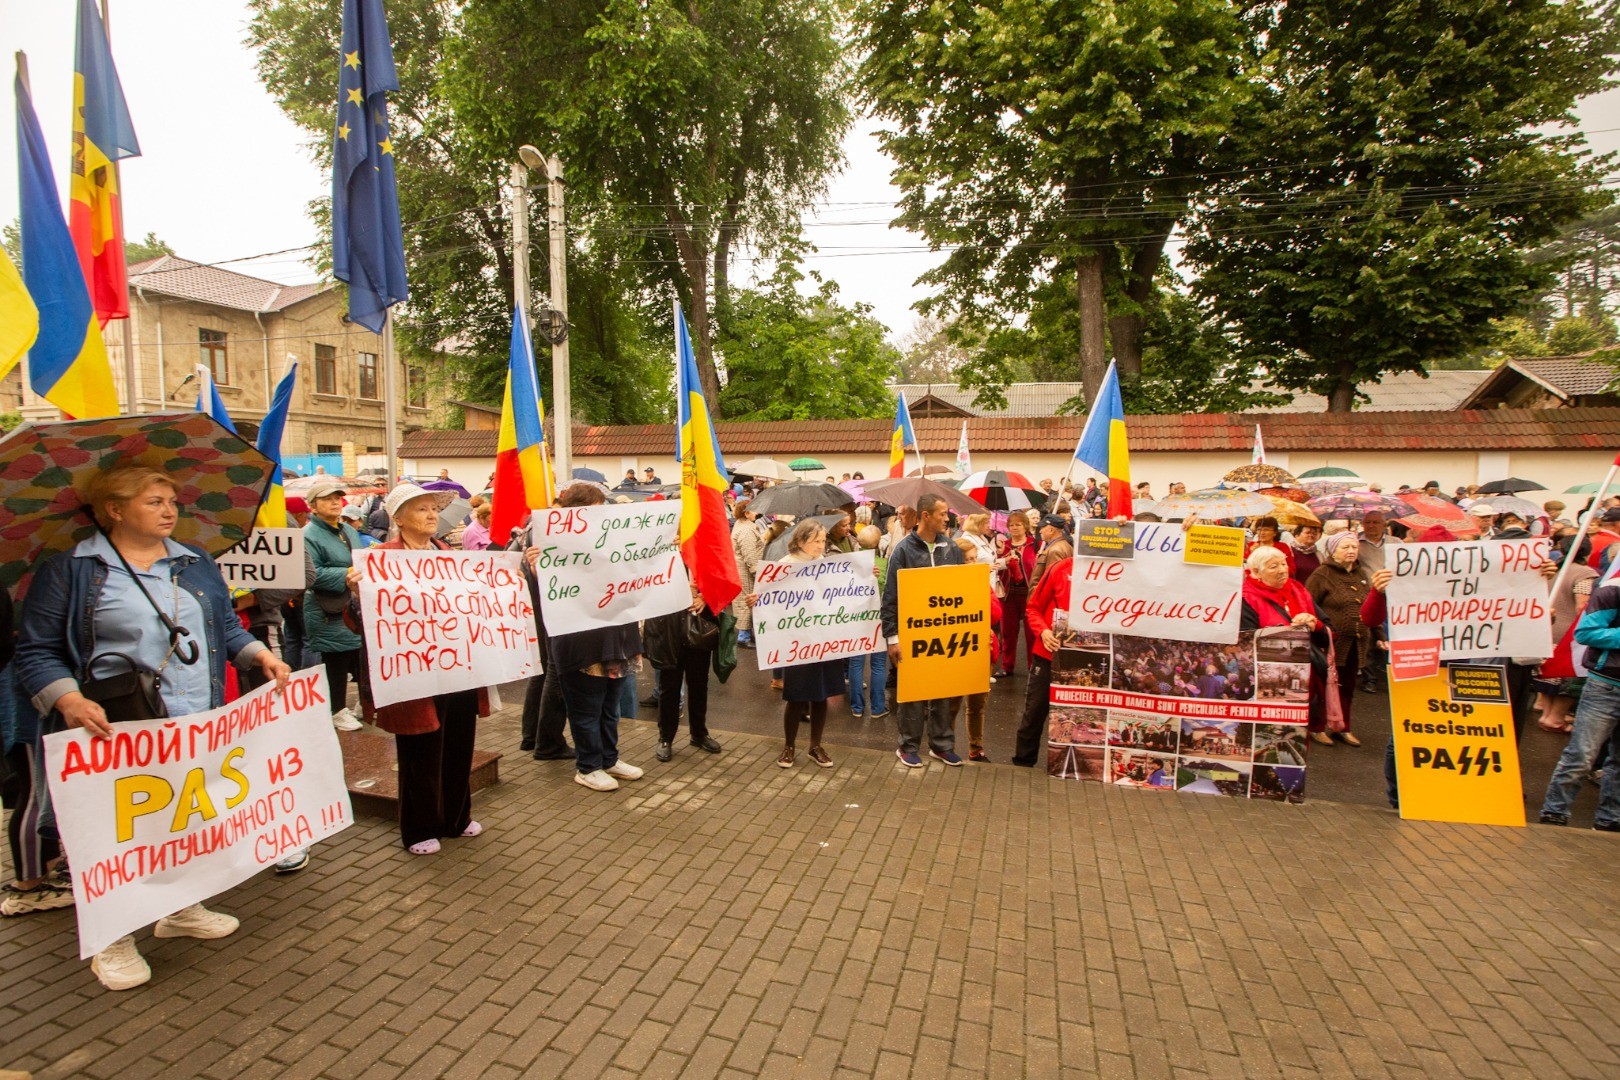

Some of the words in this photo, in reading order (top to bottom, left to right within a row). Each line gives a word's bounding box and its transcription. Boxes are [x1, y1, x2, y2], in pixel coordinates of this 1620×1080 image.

[546, 507, 588, 536] PAS
[595, 511, 677, 549] должна
[1093, 526, 1121, 536] STOP
[231, 530, 293, 556] NĂU
[367, 551, 402, 583] Nu
[540, 546, 592, 569] быть
[1085, 561, 1125, 582] не
[1396, 546, 1490, 577] ВЛАСТЬ
[1501, 541, 1546, 573] PAS
[218, 563, 276, 582] TRU
[548, 575, 581, 601] вне
[598, 555, 676, 609] закона!
[755, 588, 815, 610] которую
[1446, 577, 1479, 597] ТЫ
[928, 595, 964, 609] Stop
[1082, 591, 1238, 628] сдадимся!
[1391, 598, 1545, 626] ИГНОРИРУЕШЬ
[758, 620, 766, 635] к
[906, 610, 984, 629] fascismul
[786, 623, 882, 663] Запретить!
[1441, 622, 1504, 651] НАС!
[1055, 690, 1094, 703] PROIECTELE
[1096, 693, 1123, 706] PENTRU
[1125, 697, 1155, 709] OAMENI
[1157, 700, 1177, 712] SUNT
[1179, 702, 1228, 716] PERICULOASE
[1230, 705, 1259, 718] PENTRU
[1427, 698, 1474, 717] Stop
[61, 721, 181, 782] ДОЛОЙ
[189, 673, 326, 759] МАРИОНЕТОК
[1403, 719, 1505, 738] fascismul
[114, 746, 250, 843] PAS
[268, 747, 304, 784] ИЗ
[81, 787, 295, 903] КОНСТИТУЦИОННОГО
[255, 814, 313, 864] СУДА
